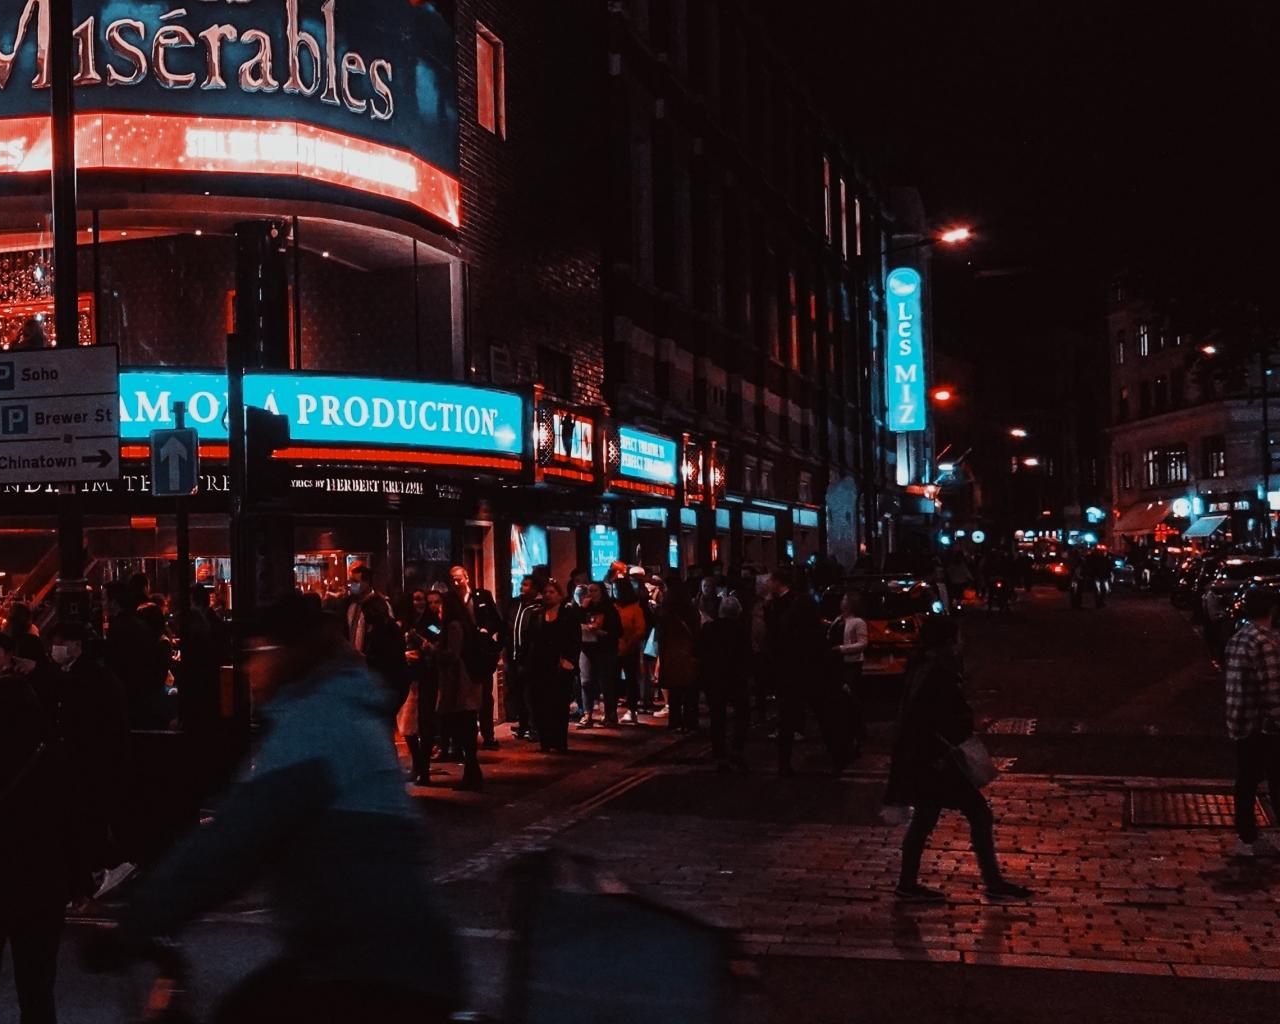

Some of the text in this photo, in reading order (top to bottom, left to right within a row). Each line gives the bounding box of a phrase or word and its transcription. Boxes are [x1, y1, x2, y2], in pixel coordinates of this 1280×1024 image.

[22, 368, 58, 382] Soho
[895, 364, 918, 424] MIZ
[188, 390, 229, 423] O
[35, 412, 88, 426] Brewer
[95, 408, 112, 423] St
[291, 479, 314, 488] YRICS
[326, 478, 380, 493] HERBERT
